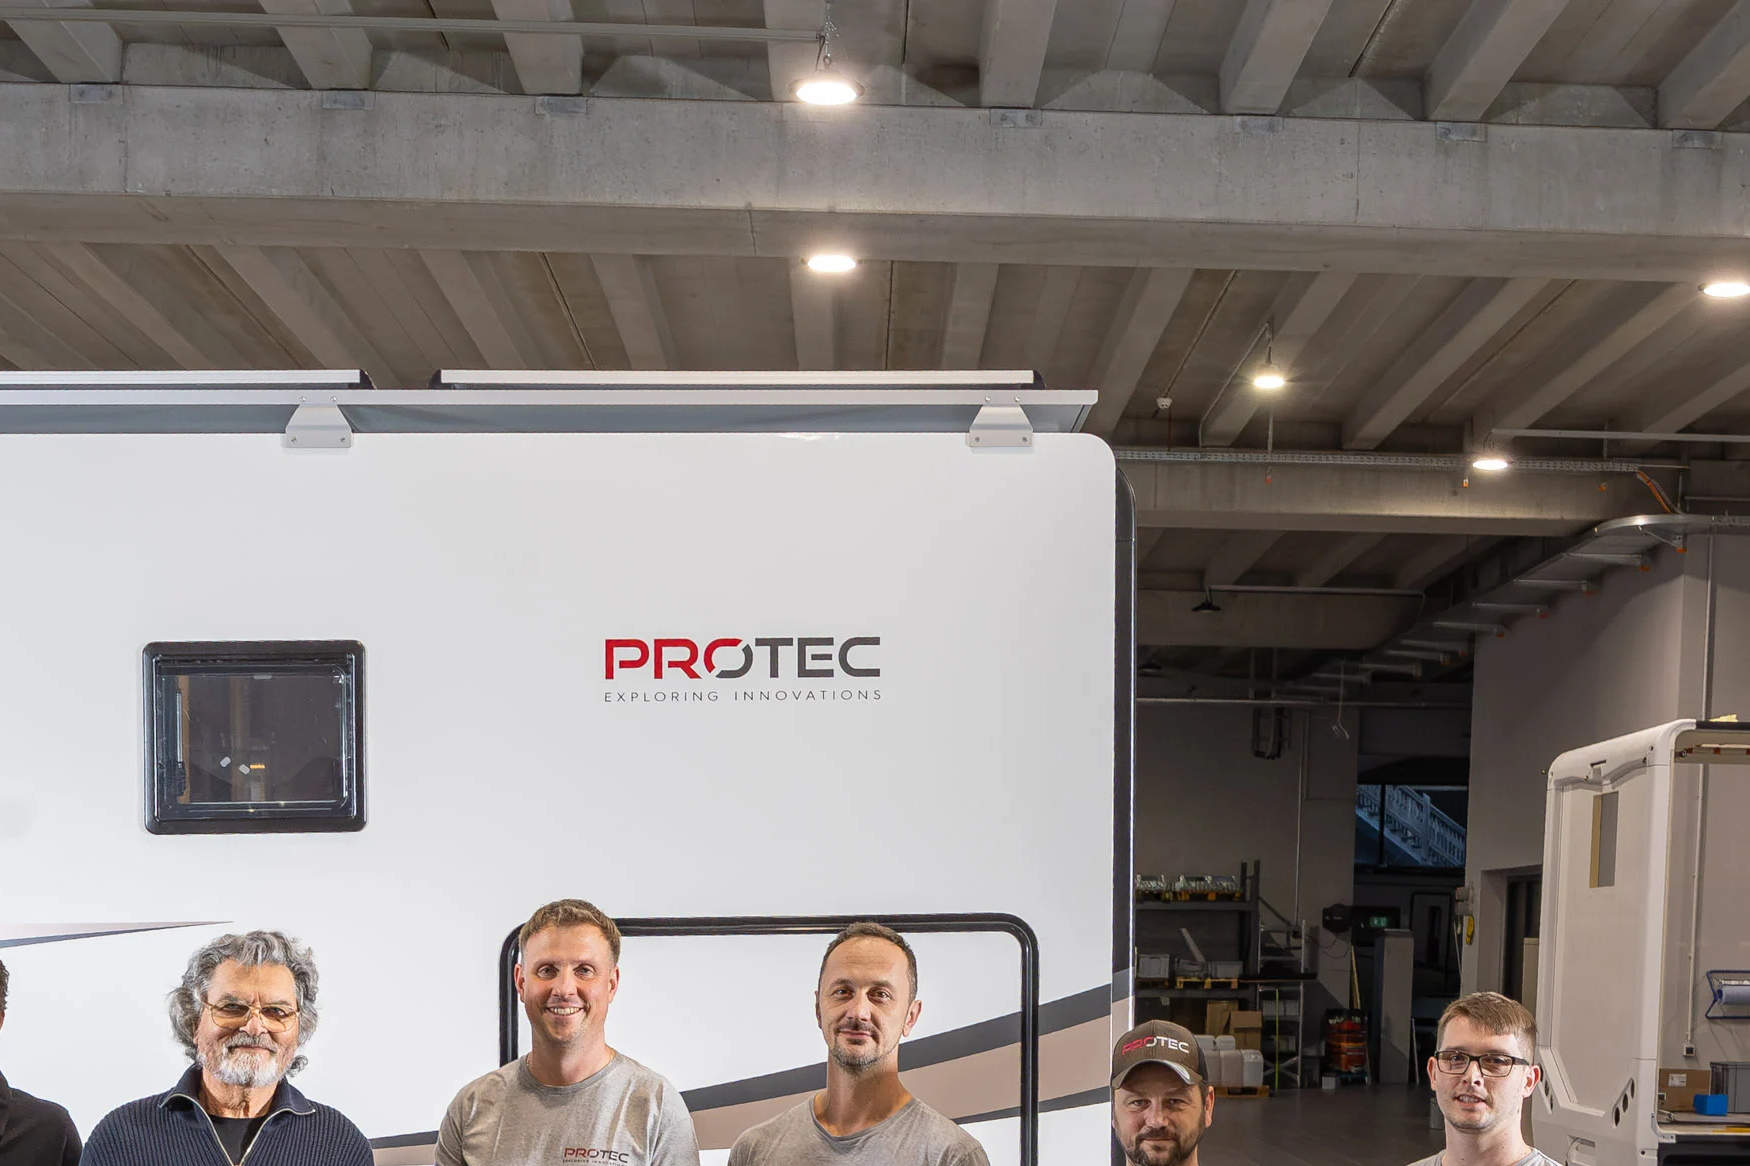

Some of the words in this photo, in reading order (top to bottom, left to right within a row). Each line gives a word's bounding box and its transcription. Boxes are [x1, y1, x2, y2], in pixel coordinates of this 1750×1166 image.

[604, 637, 881, 680] PROTEC
[604, 691, 720, 703] EXPLORING
[734, 689, 882, 702] INNOVATIONS
[1121, 1035, 1190, 1056] PROTEC
[563, 1147, 630, 1164] PROTEC
